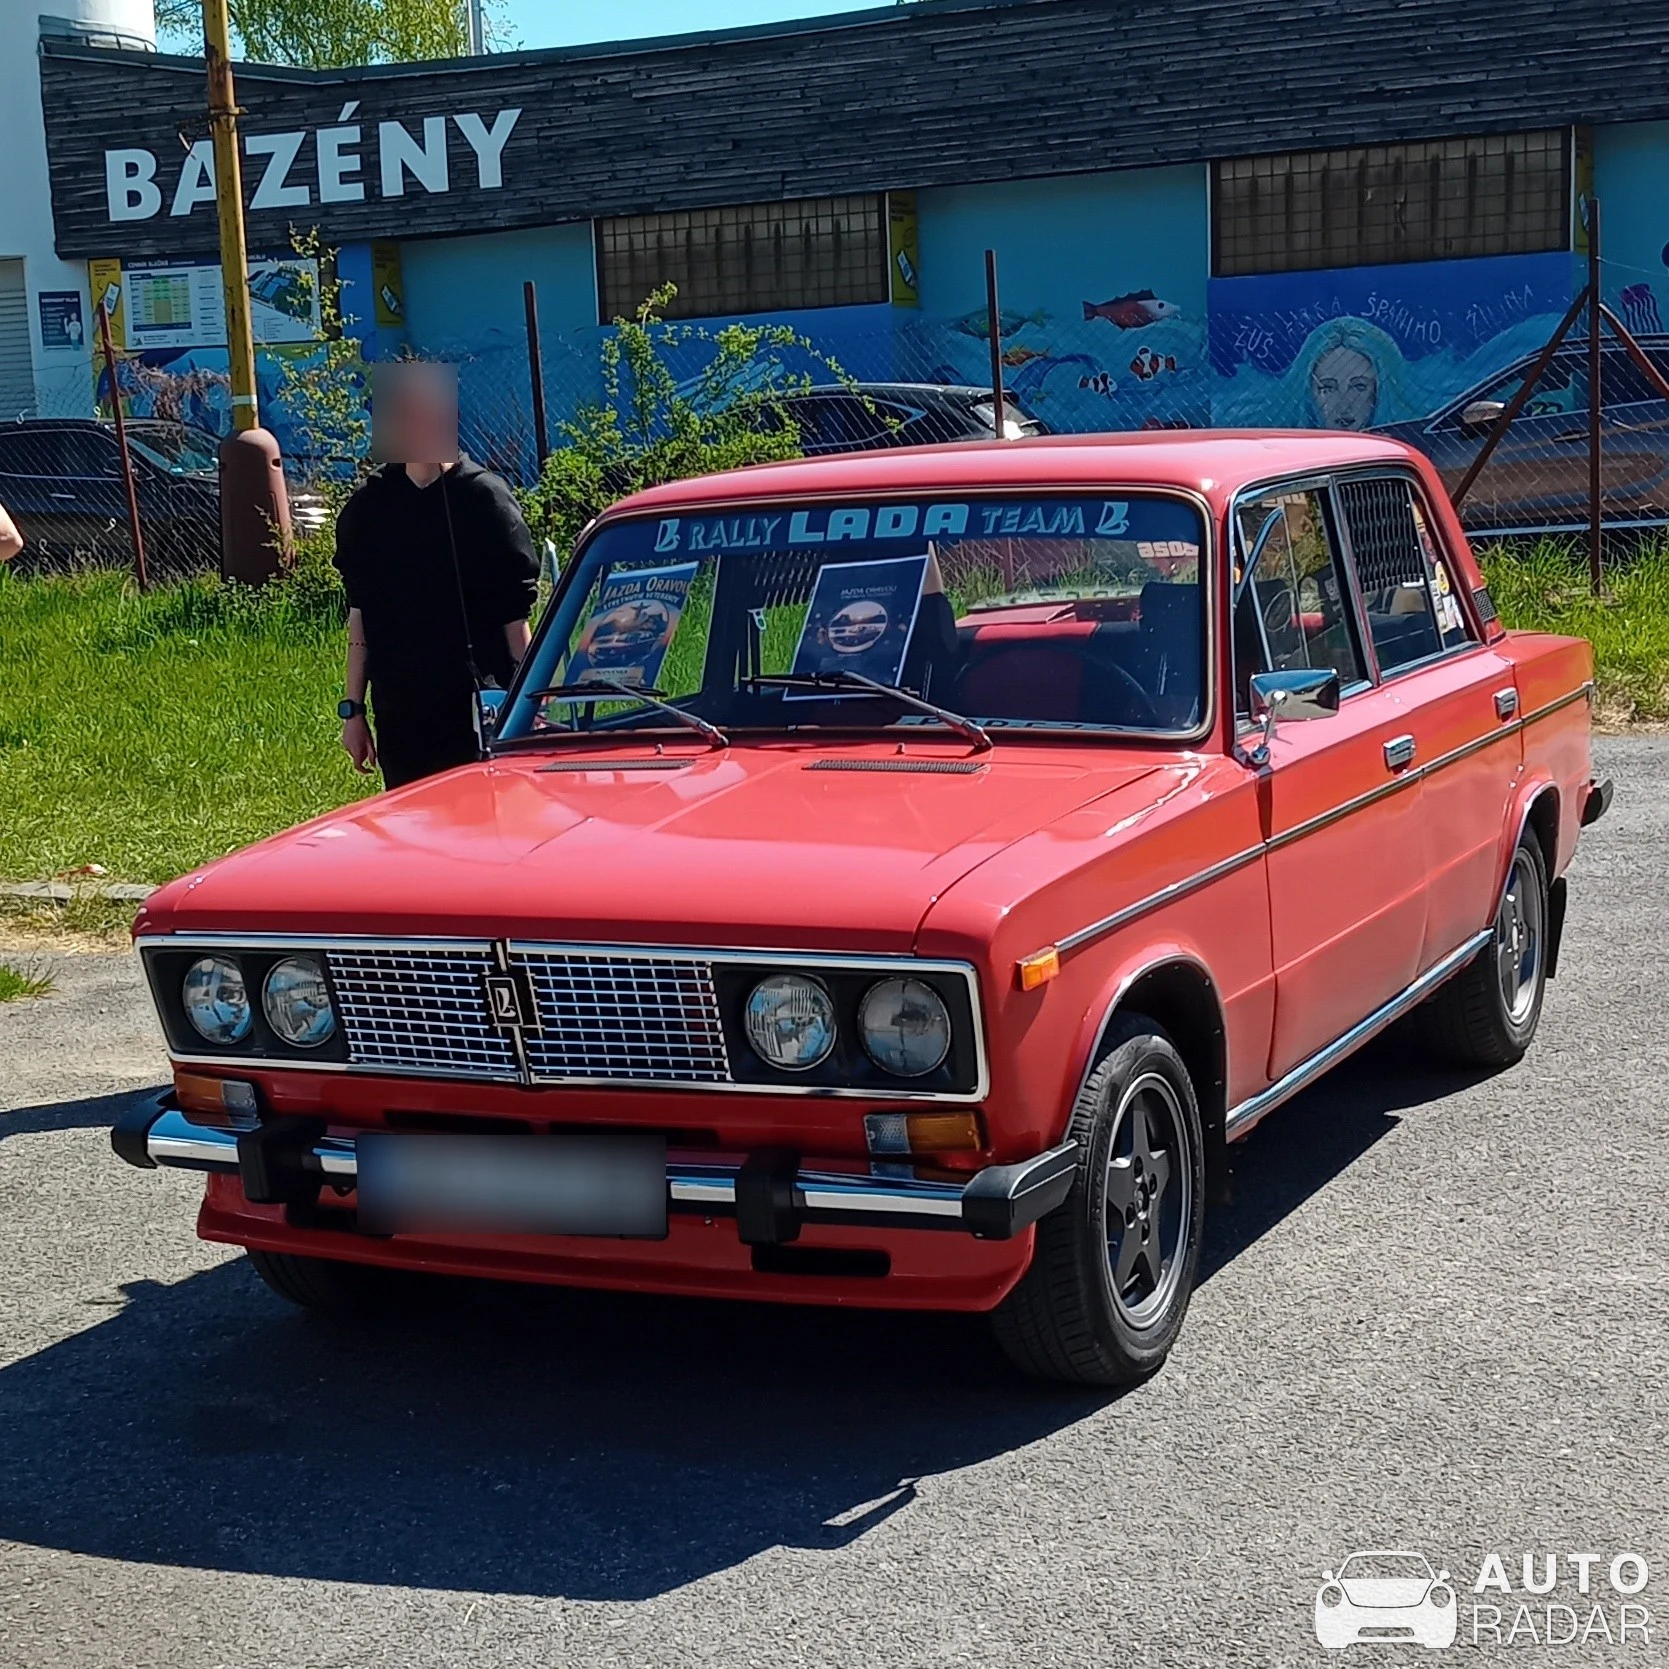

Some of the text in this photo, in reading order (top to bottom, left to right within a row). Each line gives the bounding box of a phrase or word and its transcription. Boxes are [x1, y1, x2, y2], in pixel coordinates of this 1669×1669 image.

[105, 101, 522, 221] BAZÉNY
[688, 504, 1085, 550] RALLY LADA TEAM
